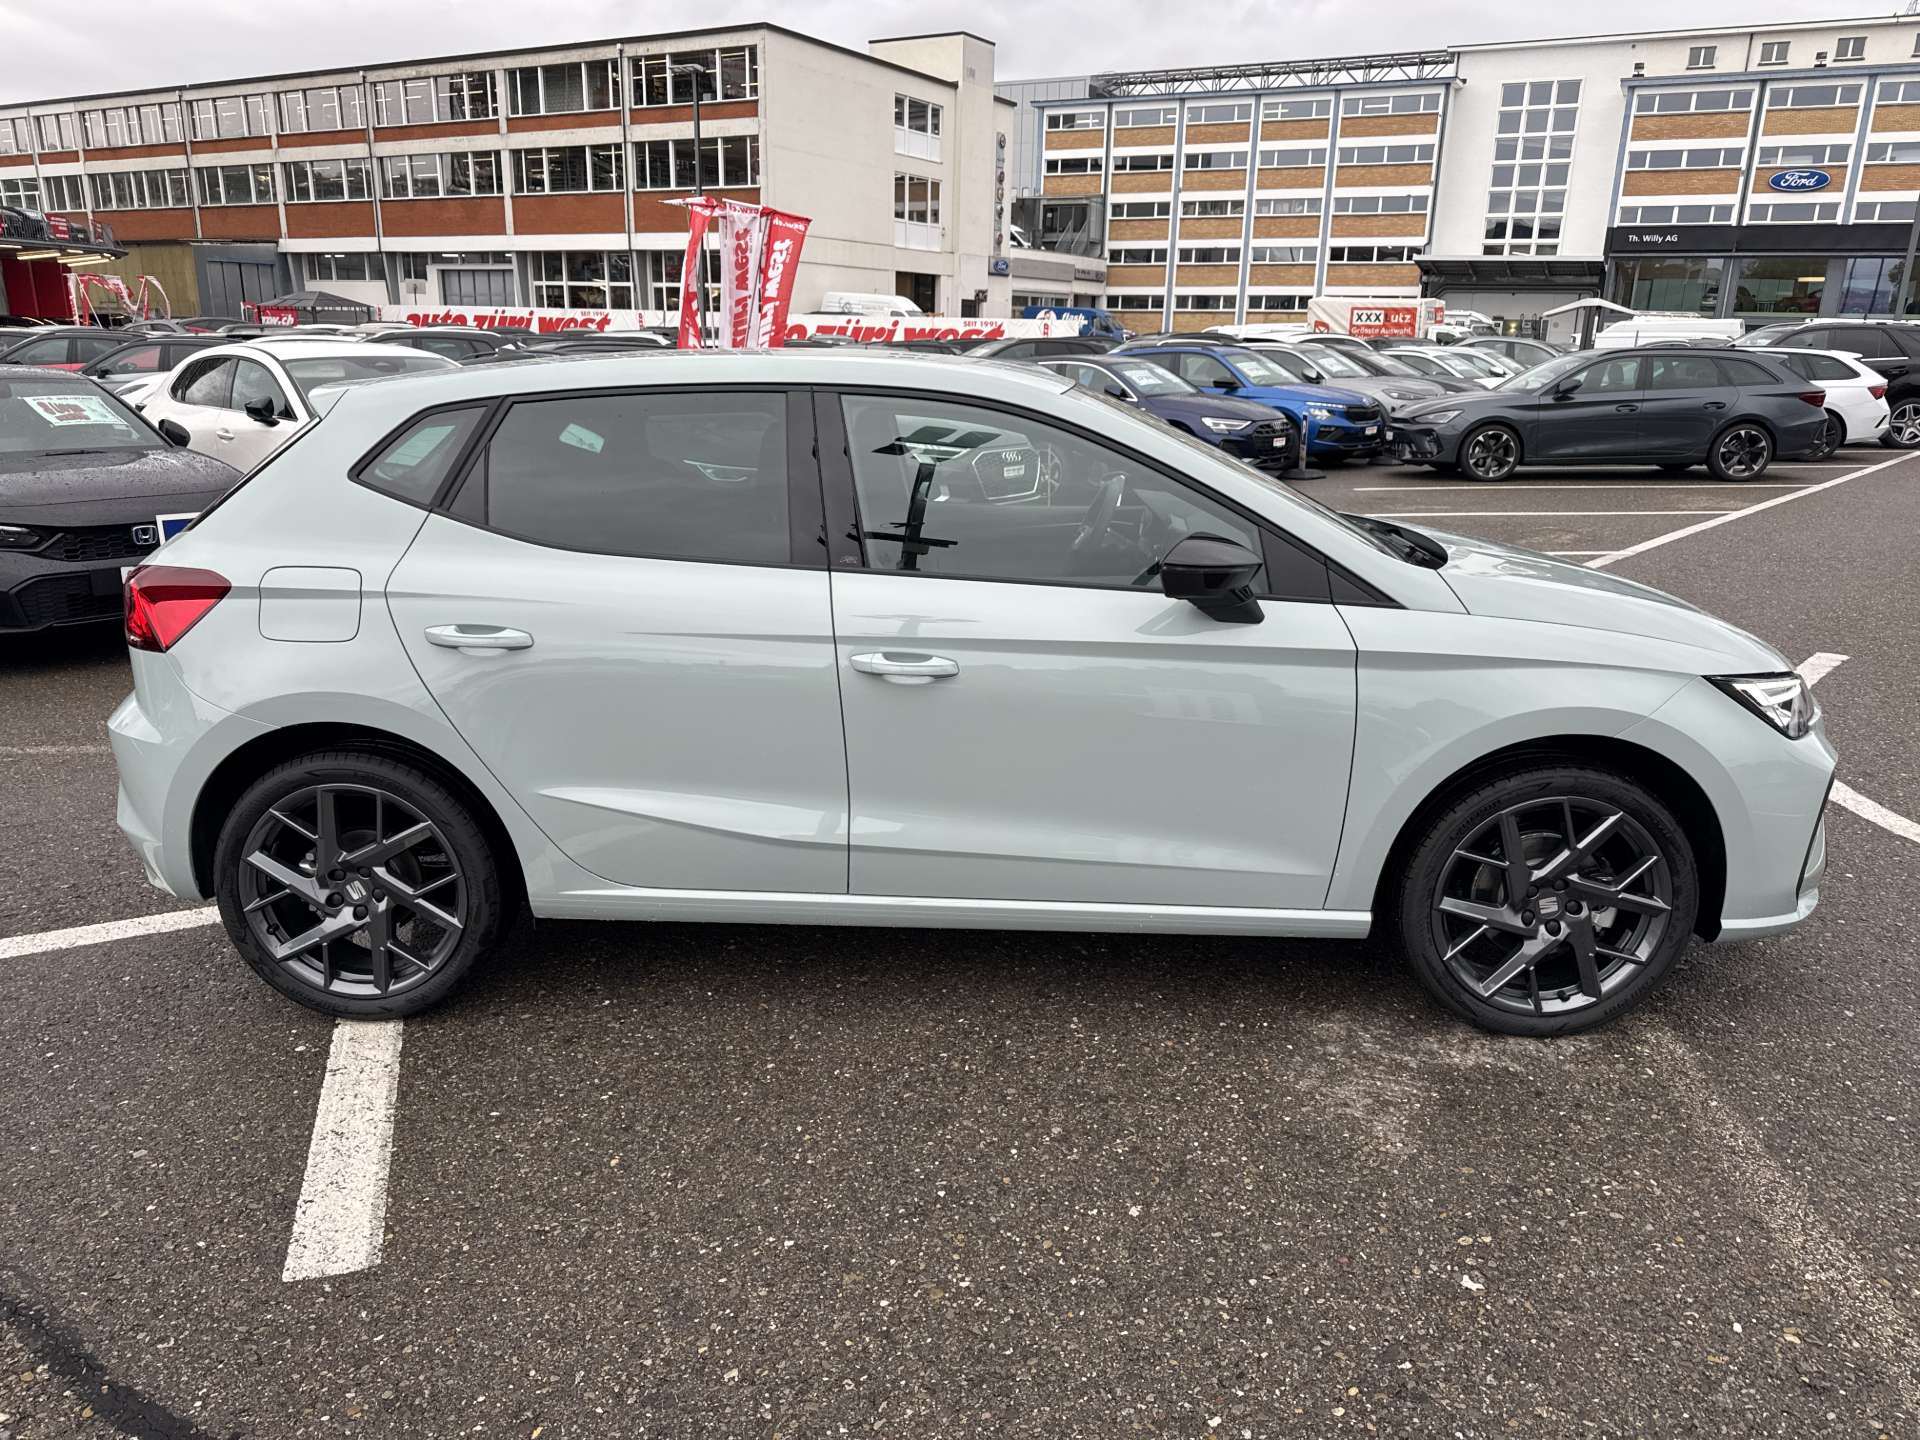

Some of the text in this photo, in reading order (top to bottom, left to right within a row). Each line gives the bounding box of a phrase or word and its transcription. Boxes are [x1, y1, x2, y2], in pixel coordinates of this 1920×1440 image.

[1780, 172, 1819, 187] Ford
[1628, 234, 1678, 244] Th. Willy AG
[963, 320, 998, 328] SEIT 1991
